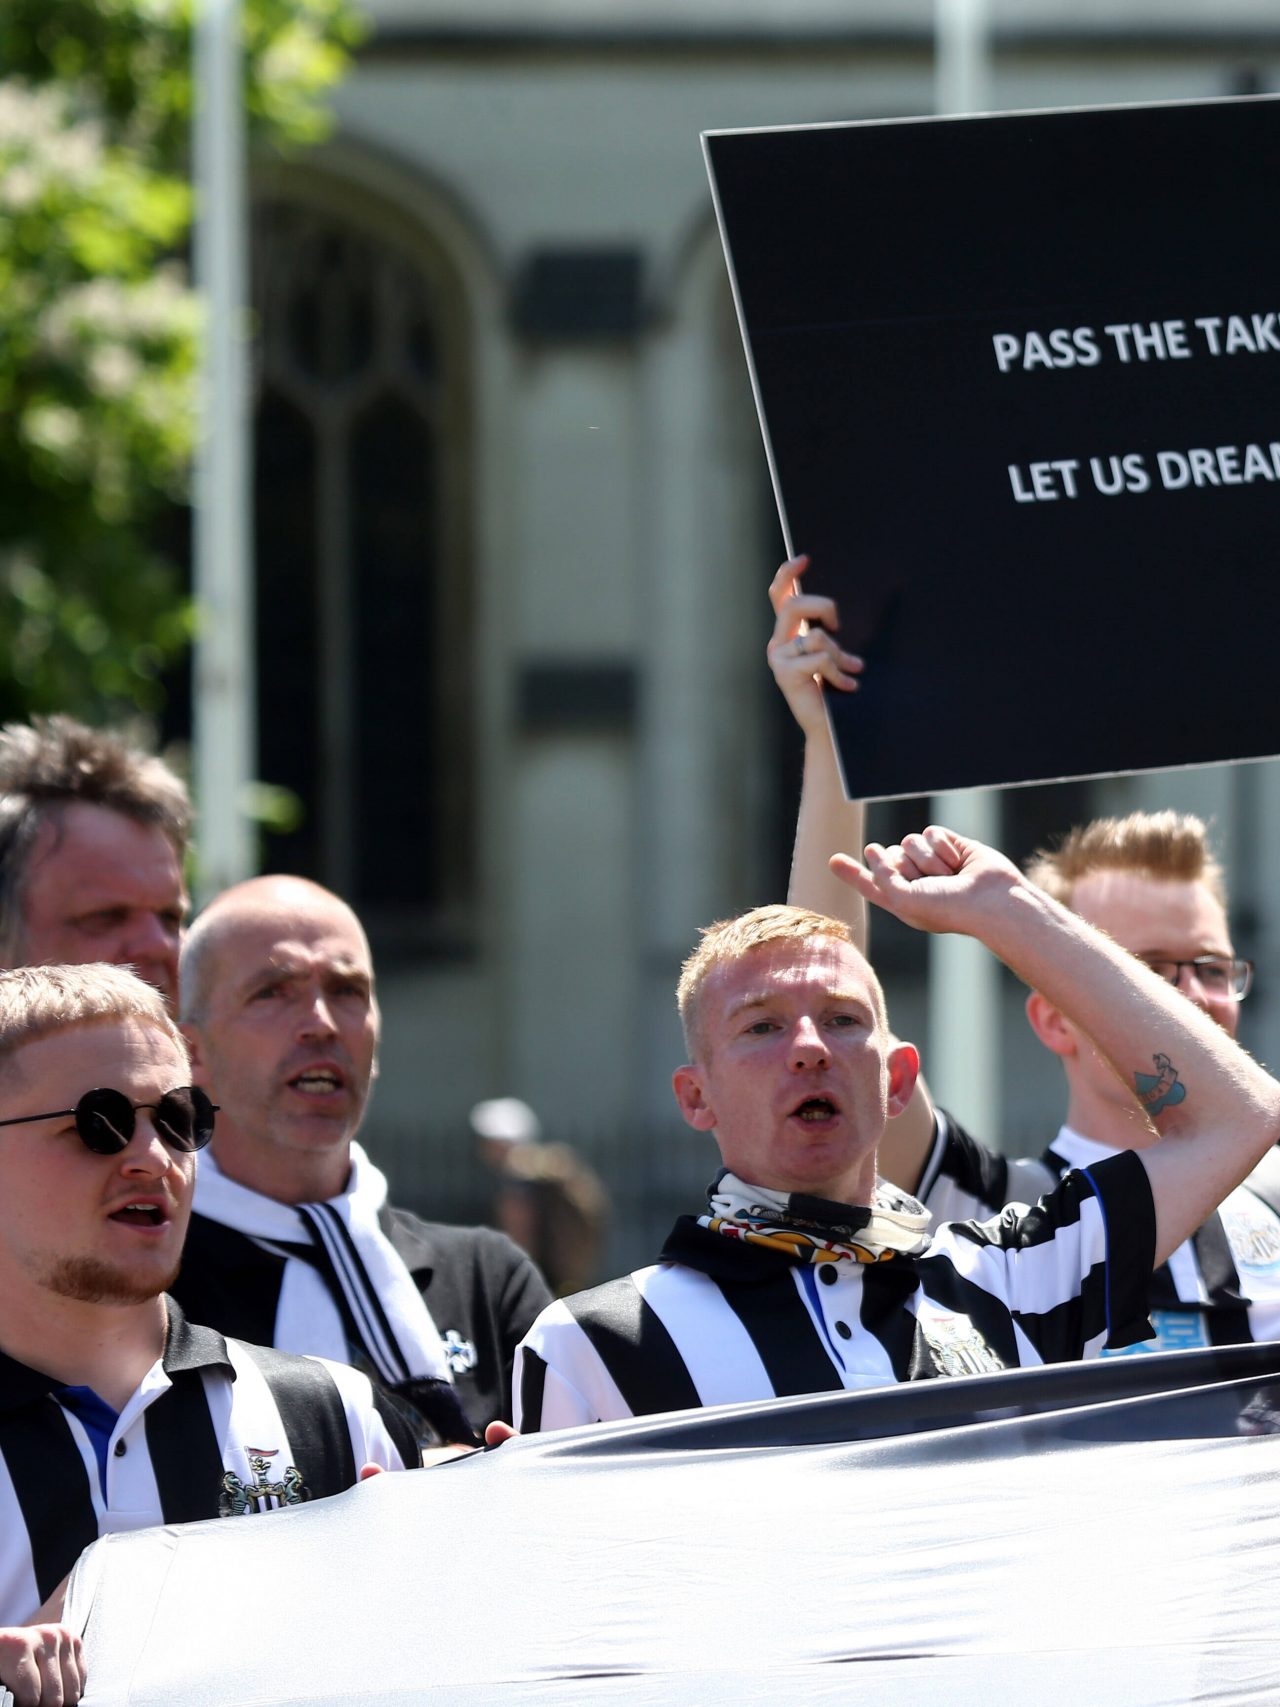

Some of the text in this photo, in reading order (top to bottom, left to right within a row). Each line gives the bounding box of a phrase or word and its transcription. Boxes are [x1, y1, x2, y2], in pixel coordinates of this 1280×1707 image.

[993, 327, 1100, 372] PASS
[1105, 320, 1191, 362] THE
[1008, 459, 1078, 502] LET
[1090, 454, 1149, 494] US
